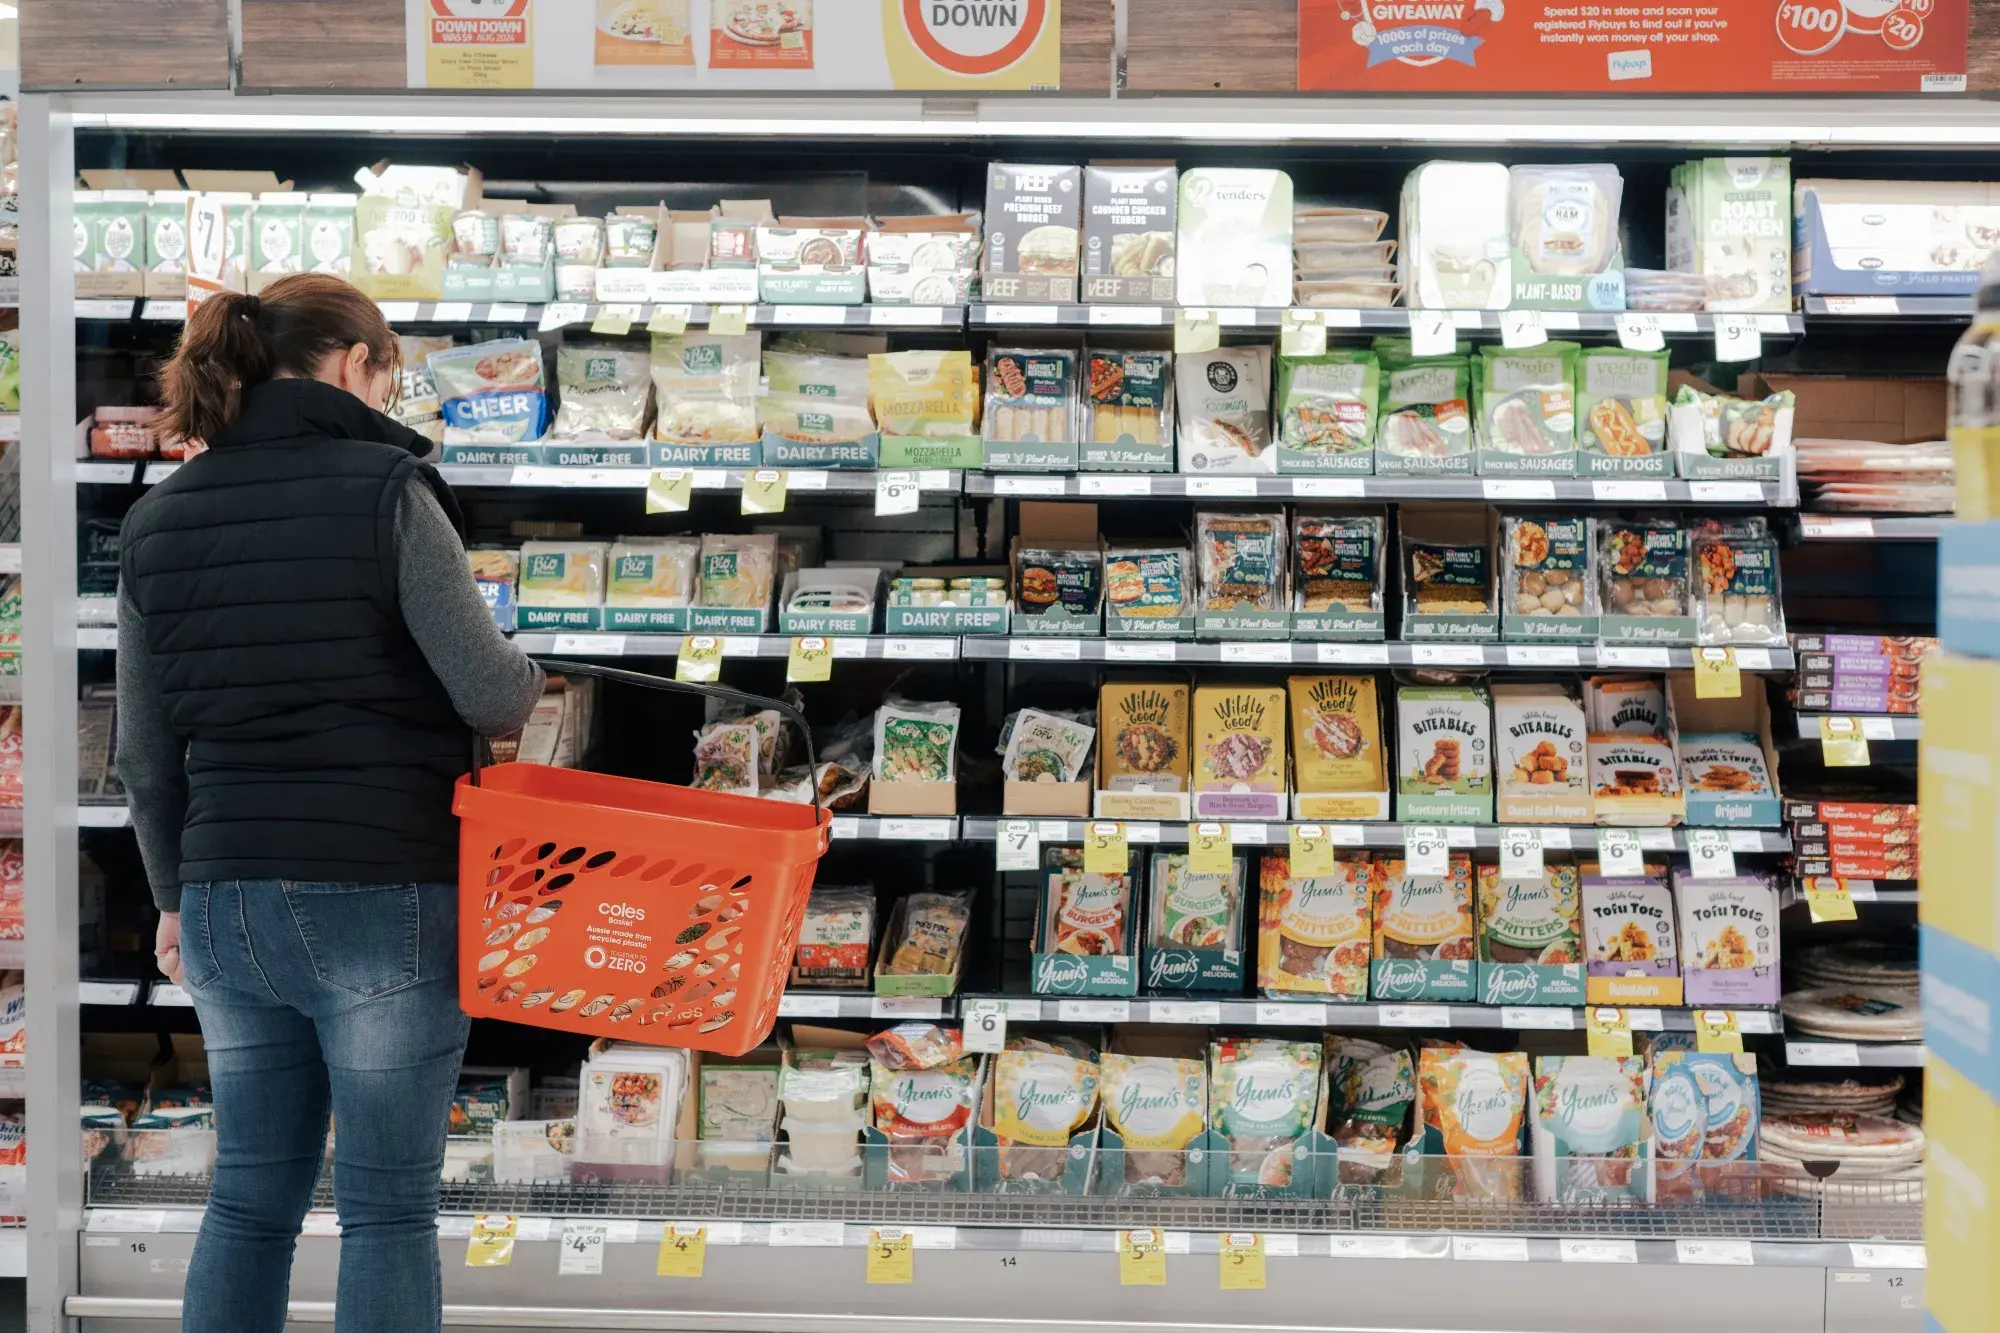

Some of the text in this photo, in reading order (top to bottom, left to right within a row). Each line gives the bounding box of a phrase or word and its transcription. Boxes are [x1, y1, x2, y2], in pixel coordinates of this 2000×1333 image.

[932, 4, 1017, 26] DOWN
[1372, 4, 1465, 21] GIVEAWAY
[1544, 5, 1718, 19] Spend $20 in store and scan your
[1782, 6, 1838, 32] $100
[435, 20, 522, 34] DOWN DOWN
[1534, 19, 1728, 32] registered Flybuys to find out if you've
[1888, 14, 1916, 41] $20
[1377, 28, 1466, 46] 1000s of prizes
[1540, 32, 1720, 45] instantly won money off your shop.
[1391, 41, 1451, 57] each day
[1612, 58, 1648, 71] Flybuys
[1003, 202, 1063, 213] PREMIUM BEEF
[1131, 205, 1167, 216] CHICKEN
[1110, 214, 1147, 226] TENDERS
[1710, 217, 1784, 237] CHICKEN
[1515, 282, 1583, 301] PLANT-BASED
[1595, 282, 1620, 294] HAM
[1595, 358, 1649, 378] vegie
[456, 394, 531, 421] CHEER
[882, 396, 960, 417] MOZZARELLA
[1204, 398, 1250, 416] Rosemary
[456, 450, 529, 465] DAIRY FREE
[559, 452, 632, 466] DAIRY FREE
[660, 447, 752, 463] DAIRY FREE
[776, 445, 868, 462] DAIRY FREE
[904, 446, 962, 458] MOZZARELLA
[1024, 453, 1069, 466] Plant Based
[1121, 450, 1166, 463] Plant Based
[1316, 457, 1371, 470] SAUSAGES
[1403, 457, 1469, 470] SAUSAGES
[1519, 458, 1574, 471] SAUSAGES
[1591, 457, 1663, 472] HOT DOGS
[1724, 463, 1772, 477] ROAST
[527, 610, 590, 624] DAIRY FREE
[615, 611, 675, 624] DAIRY FREE
[695, 614, 755, 627] DAIRY FREE
[788, 618, 857, 632] DAIRY FREE
[902, 612, 992, 627] DAIRY FREE
[1133, 618, 1180, 632] Plant Based
[1240, 617, 1284, 630] Plant Based
[1333, 618, 1378, 631] Plant Based
[1039, 619, 1085, 632] Plant Based
[1449, 623, 1493, 635] Plant Based
[1535, 622, 1583, 634] Plant Based
[1633, 626, 1680, 639] Plant Based
[1308, 677, 1359, 703] Wildly
[1119, 688, 1171, 716] Wildly
[1213, 694, 1267, 721] Wildly
[1611, 706, 1658, 728] BITEABLES
[1031, 727, 1055, 739] TOFU
[1412, 717, 1478, 737] BITEABLES
[1509, 721, 1574, 739] BITEABLES
[1597, 755, 1663, 768] BITEABLES
[1684, 754, 1758, 766] VEGGIE STRIPS
[1450, 802, 1481, 816] Fritters
[1714, 803, 1752, 820] Original
[1007, 833, 1029, 851] $7
[1409, 839, 1445, 856] $650
[1503, 840, 1539, 857] $650
[1602, 842, 1638, 858] $650
[1077, 884, 1109, 906] Yumi's
[1299, 878, 1344, 908] Yumi's
[1401, 878, 1443, 908] Yumi's
[1506, 882, 1551, 912] Yumi's
[598, 902, 646, 921] coles
[1172, 894, 1223, 915] BURGERS
[1592, 902, 1663, 921] Tofu Tots
[1066, 909, 1116, 930] BURGERS
[1692, 903, 1764, 923] Tofu Tots
[608, 916, 634, 927] Basket
[1285, 913, 1357, 936] FRITTERS
[1387, 913, 1458, 936] FRITTERS
[1494, 916, 1564, 937] FRITTERS
[586, 924, 652, 942] Aussie made from
[588, 933, 648, 950] recycled plastic
[609, 949, 648, 961] TOGETHER TO
[607, 956, 646, 974] ZERO
[1147, 955, 1201, 988] Yumi's
[1211, 964, 1231, 972] REAL.
[1036, 957, 1090, 995] Yumi's
[1091, 976, 1129, 985] DELICIOUS.
[1100, 970, 1119, 978] REAL.
[1202, 970, 1239, 980] DELICIOUS.
[1375, 962, 1429, 999] Yumi's
[1487, 970, 1541, 1005] Yumi's
[1541, 986, 1580, 995] DELICIOUS.
[1550, 980, 1571, 989] REAL.
[1608, 983, 1660, 998] Sweetcorn
[974, 1013, 997, 1032] $6
[898, 1077, 953, 1117] Yumi's
[1017, 1078, 1077, 1122] Yumi's
[1235, 1075, 1295, 1113] Yumi's
[1118, 1082, 1182, 1126] Yumi's
[1458, 1086, 1508, 1132] Yumi's
[1560, 1084, 1620, 1128] Yumi's
[129, 1242, 146, 1254] 16
[565, 1235, 601, 1253] $450
[1000, 1256, 1017, 1267] 14
[1886, 1277, 1905, 1288] 12
